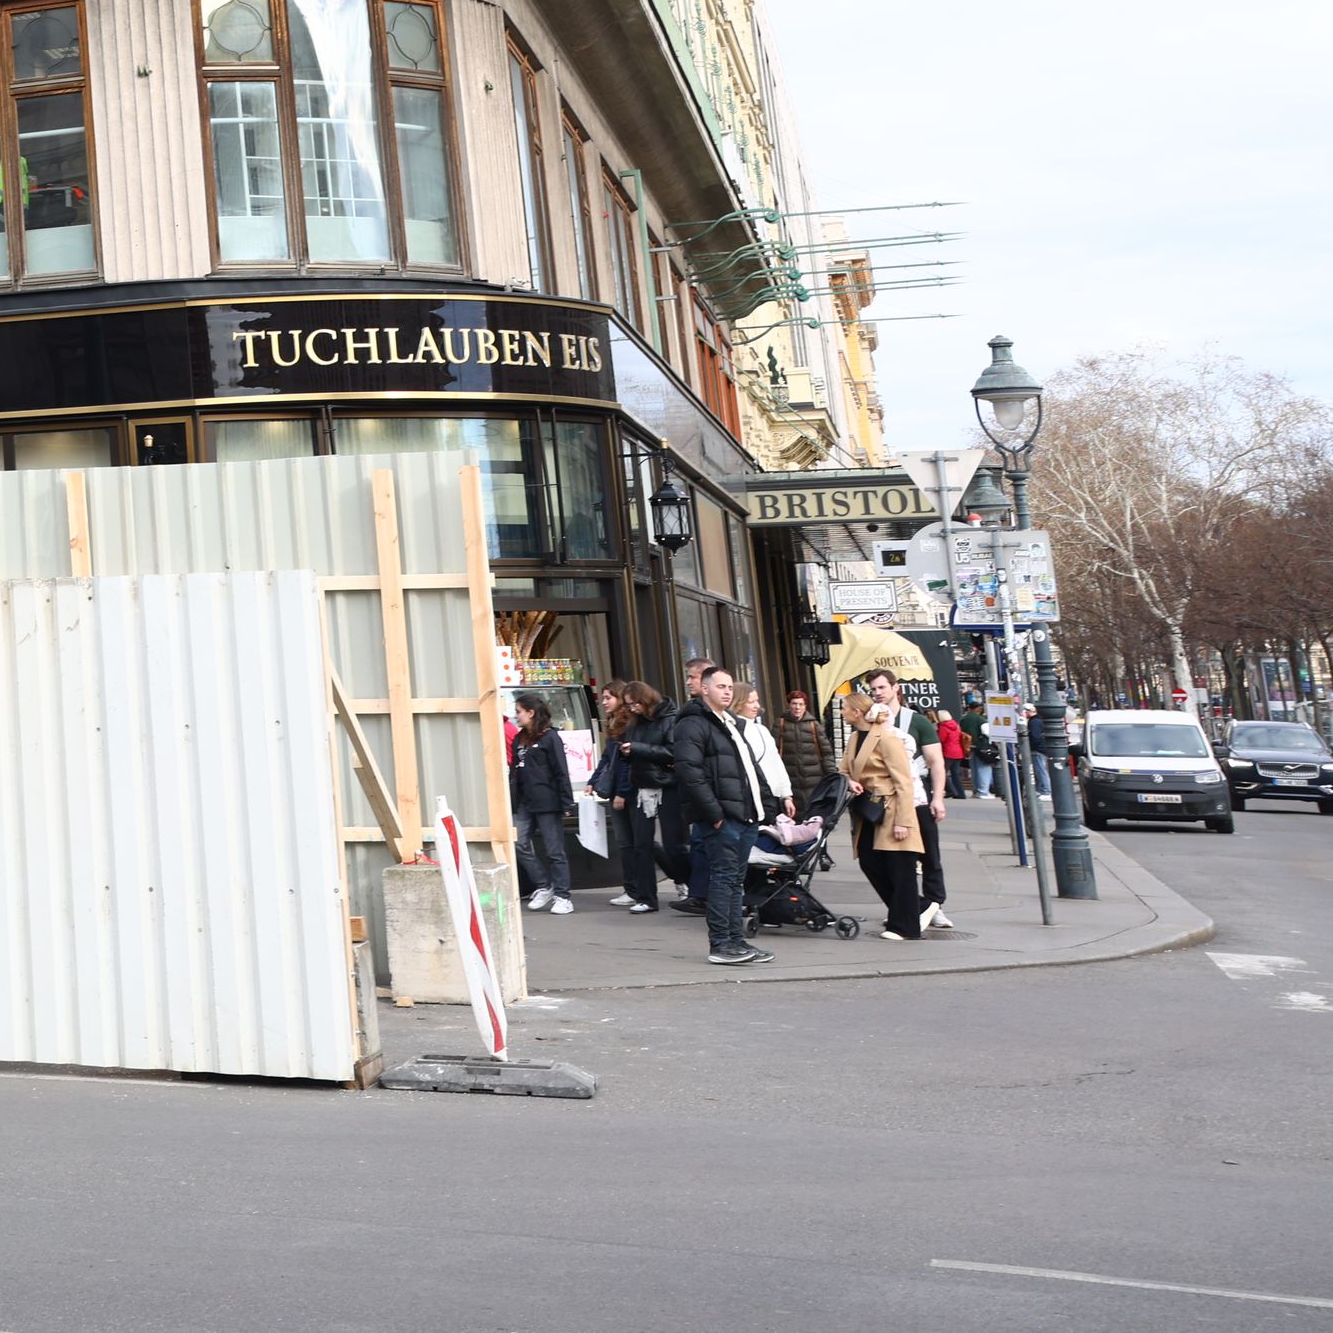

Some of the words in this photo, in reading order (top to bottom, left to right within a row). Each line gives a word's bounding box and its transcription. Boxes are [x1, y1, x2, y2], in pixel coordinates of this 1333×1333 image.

[233, 327, 551, 368] TUCHLAUBEN
[561, 333, 602, 373] EIS
[755, 487, 936, 520] BRISTOL
[839, 588, 871, 597] HOUSE
[873, 587, 887, 596] OF
[840, 596, 887, 606] PRESENTS
[874, 655, 921, 667] SOUVENIR
